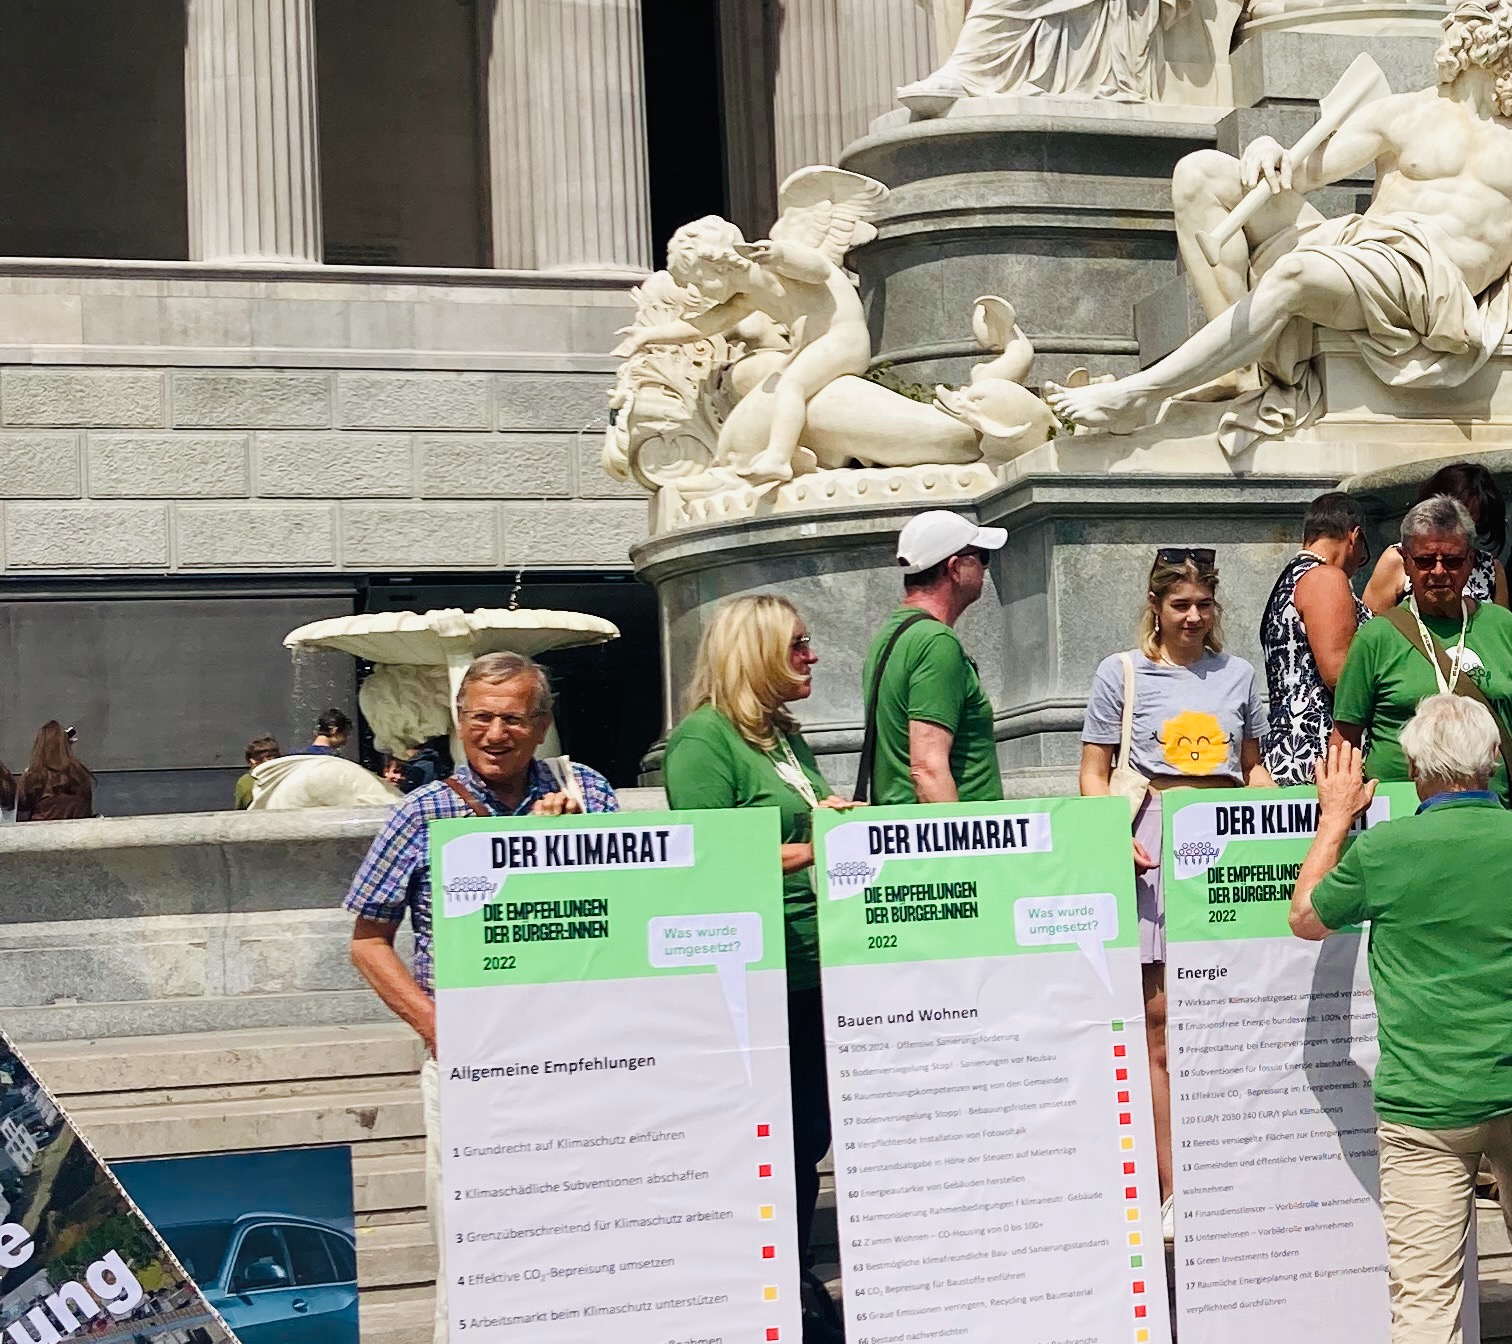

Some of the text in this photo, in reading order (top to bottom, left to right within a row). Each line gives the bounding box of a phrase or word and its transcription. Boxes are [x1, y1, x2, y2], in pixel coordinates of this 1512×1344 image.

[1215, 802, 1367, 835] DER KLIM
[868, 818, 1028, 854] DER KLIMARAT
[491, 831, 668, 868] DER KLIMARAT
[1207, 863, 1302, 884] DIE EMPFEHLUNG
[864, 881, 976, 904] DIE EMPFEHLUNGEN
[1208, 883, 1295, 904] DER BÜRGER:IN
[483, 899, 608, 922] DIE EMPFEHLUNGEN
[865, 901, 978, 924] DER BÜRGER:INNEN
[1027, 905, 1094, 918] Was wurde
[1208, 909, 1236, 923] 2022
[484, 920, 608, 944] DER BÜRGER:INNEN
[663, 925, 737, 938] Was wurde
[1029, 920, 1098, 935] umgesetzt?
[664, 940, 741, 957] umgesetzt?
[867, 934, 897, 949] 2022
[483, 955, 516, 970] 2022
[1177, 965, 1227, 980] Energie
[837, 1008, 977, 1027] Bauen und Wohnen
[450, 1056, 655, 1081] Allgemeine Empfehlungen
[452, 1130, 684, 1158] 1 Grundrecht auf Klimaschutz einführen
[465, 1182, 559, 1198] Klimaschädliche
[562, 1177, 642, 1191] Subventionen
[646, 1169, 708, 1184] abschaffen
[455, 1210, 733, 1243] 3 Grenzüberschreitend für Klimaschutz arbeiten
[468, 1272, 520, 1285] Effektive
[619, 1258, 674, 1270] umsetzen
[885, 1282, 930, 1293] Bepreisung
[946, 1275, 985, 1286] Baustoffe
[458, 1295, 728, 1330] 5 Arbeitsmarkt beim Klimaschutz unterstützen
[1186, 1301, 1237, 1314] verpflichtend
